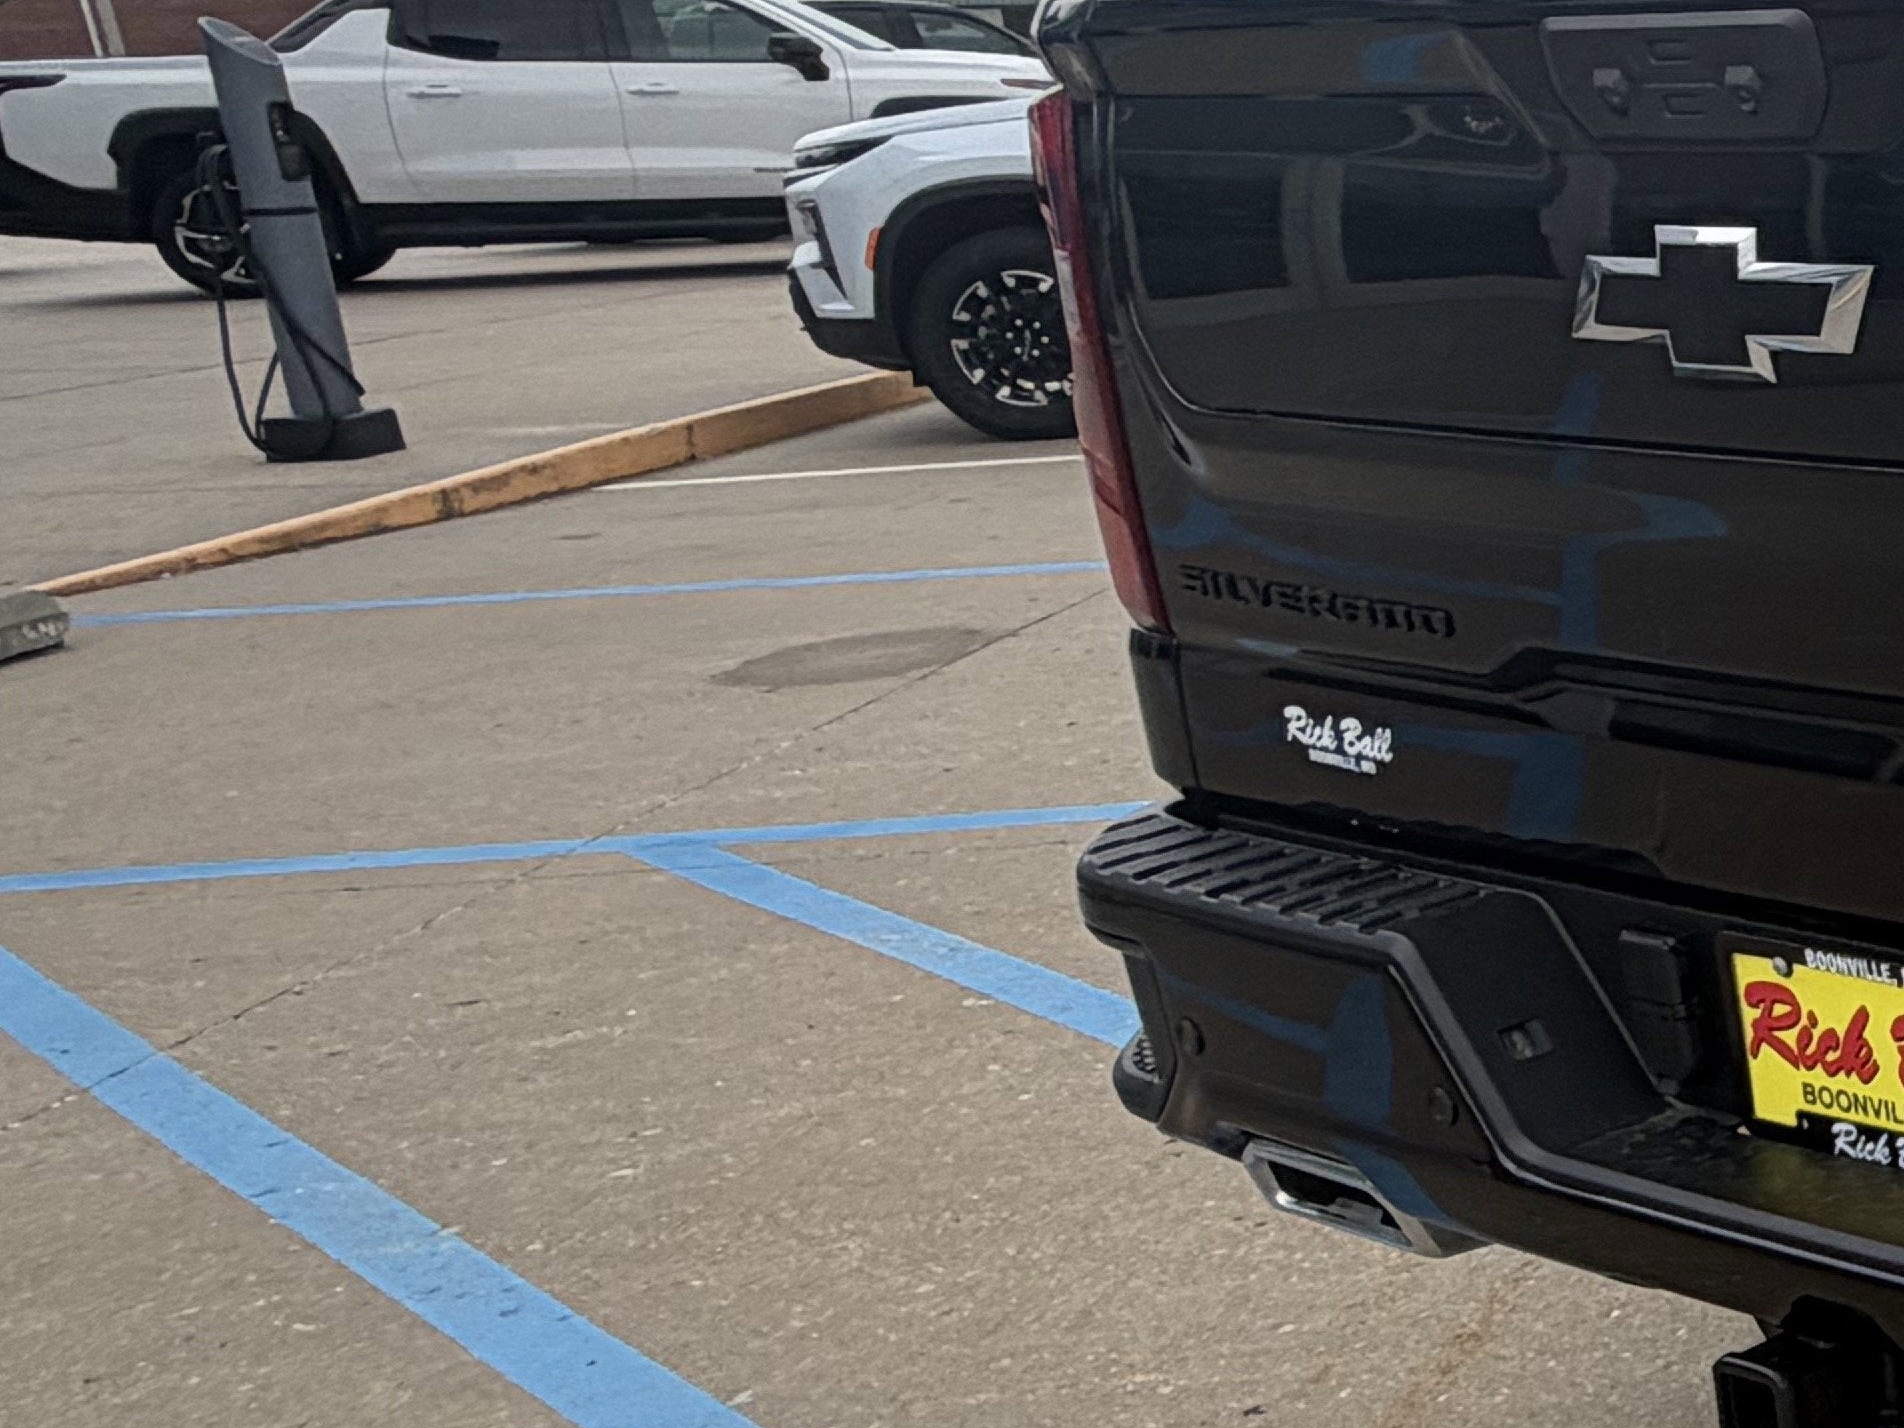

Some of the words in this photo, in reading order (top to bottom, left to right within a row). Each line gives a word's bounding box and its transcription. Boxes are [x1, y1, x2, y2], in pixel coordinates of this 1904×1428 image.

[1283, 705, 1337, 750] Rick
[1339, 716, 1393, 763] Ball
[1804, 948, 1897, 986] BOONVILLE,
[1744, 981, 1879, 1084] Rick
[1831, 1123, 1891, 1165] Rick
